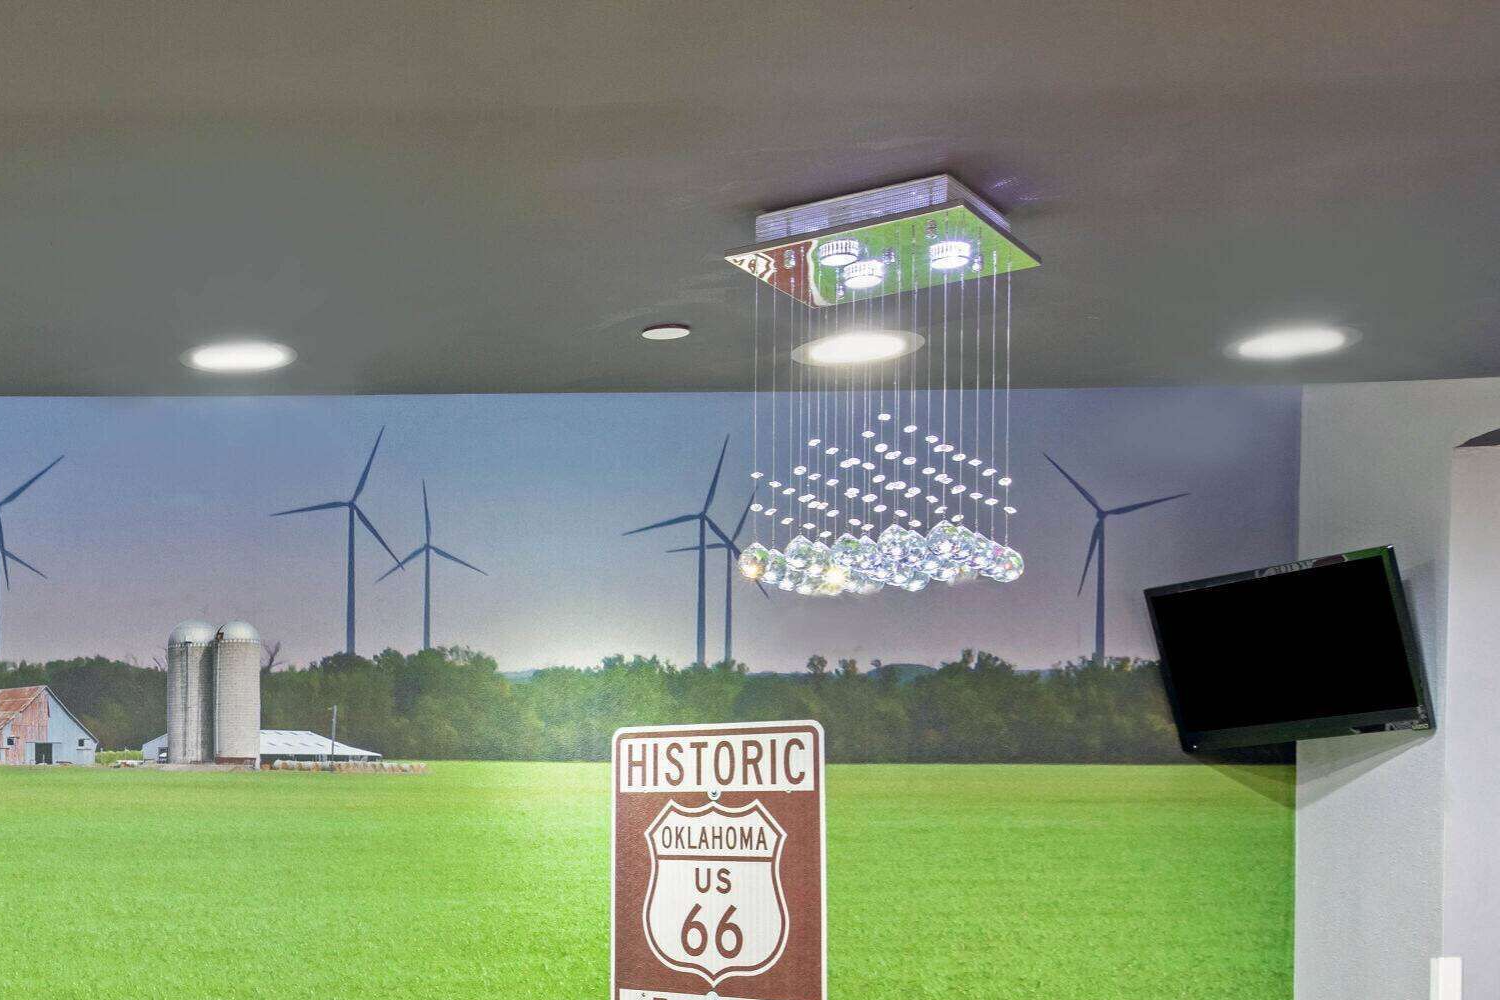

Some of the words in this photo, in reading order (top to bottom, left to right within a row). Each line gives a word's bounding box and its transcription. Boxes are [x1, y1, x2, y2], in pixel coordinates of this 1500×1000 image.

[627, 738, 805, 787] HISTORIC
[661, 825, 768, 851] OKLAHOMA
[695, 867, 732, 894] US
[681, 903, 744, 958] 66
